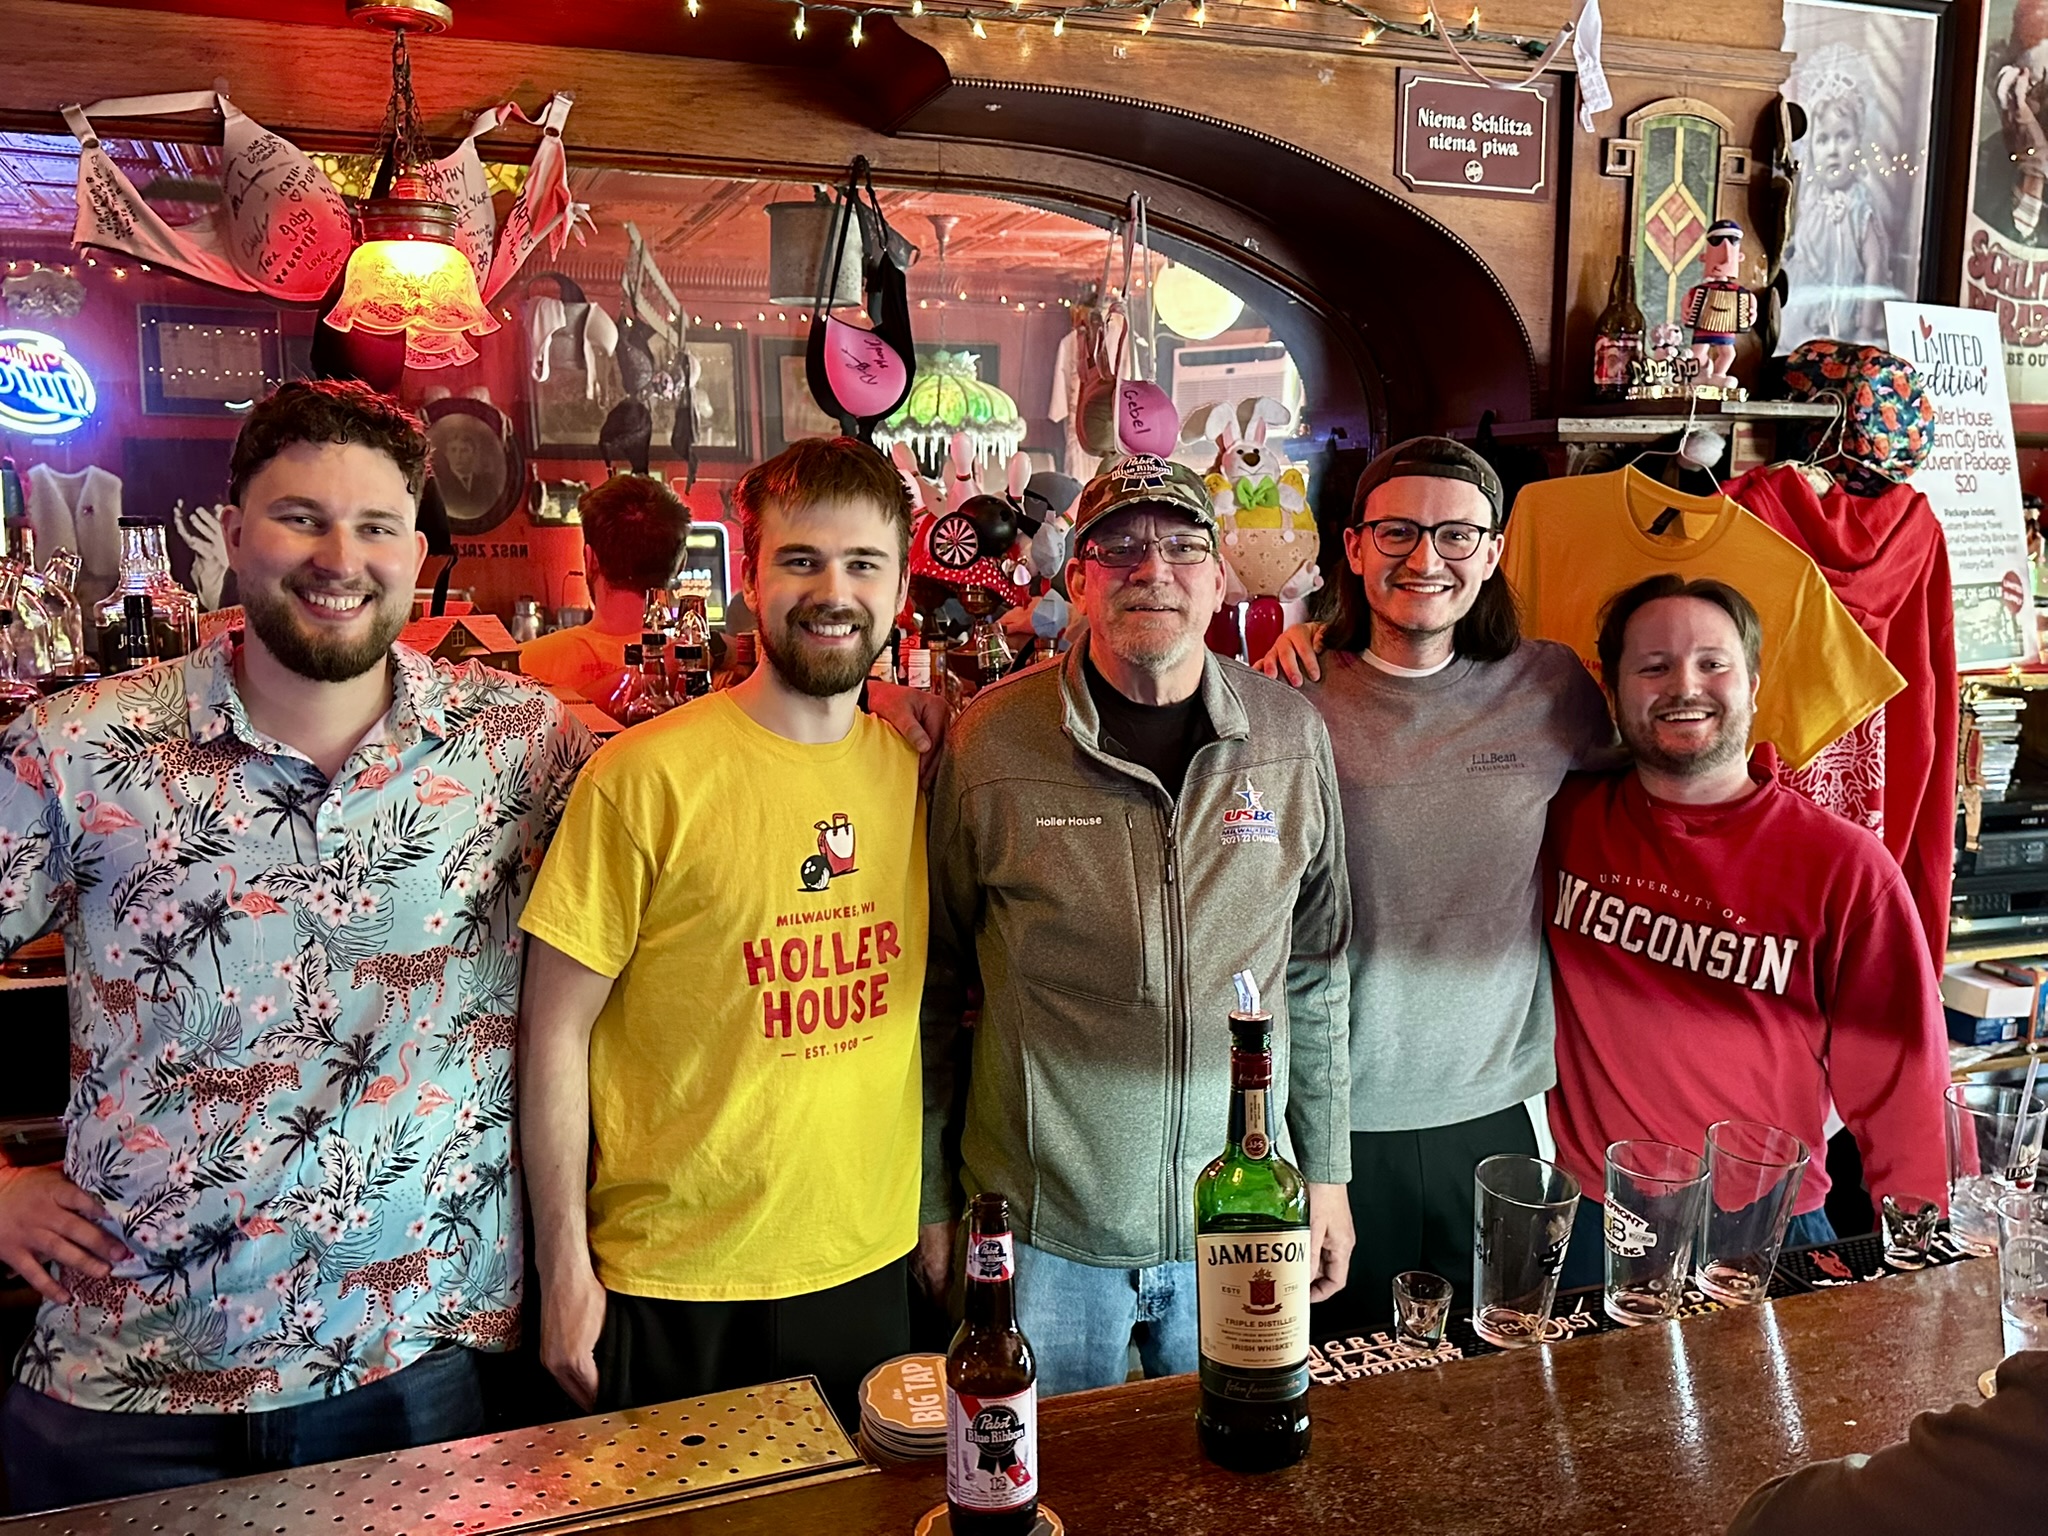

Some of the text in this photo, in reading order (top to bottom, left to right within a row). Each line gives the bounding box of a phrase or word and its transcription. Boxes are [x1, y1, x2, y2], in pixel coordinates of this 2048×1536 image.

[1417, 107, 1534, 137] Niema Schlitza
[1429, 132, 1520, 159] niema piwa
[2006, 353, 2048, 367] BE OU
[1123, 389, 1152, 435] Gebel
[1932, 405, 1993, 427] oller House
[1964, 451, 2011, 475] Package
[1955, 473, 1978, 496] $20
[1036, 815, 1103, 827] Holler House
[1223, 808, 1276, 824] USBC
[861, 901, 875, 915] WI
[1600, 873, 1747, 926] UNIVERSITY OF
[1553, 869, 1800, 996] WISCONSIN
[743, 920, 902, 987] HOLLER
[763, 972, 889, 1040] HOUSE
[805, 1044, 830, 1060] EST.
[1207, 1241, 1308, 1267] JAMESON
[1225, 1316, 1298, 1328] TRIPLE DISTILLED
[1231, 1341, 1294, 1352] IRISH WHISKEY
[901, 1362, 946, 1423] BIG TAP
[979, 1413, 1012, 1431] Pabst
[967, 1428, 1025, 1444] Blue Ribbon
[989, 1475, 1007, 1491] 12
